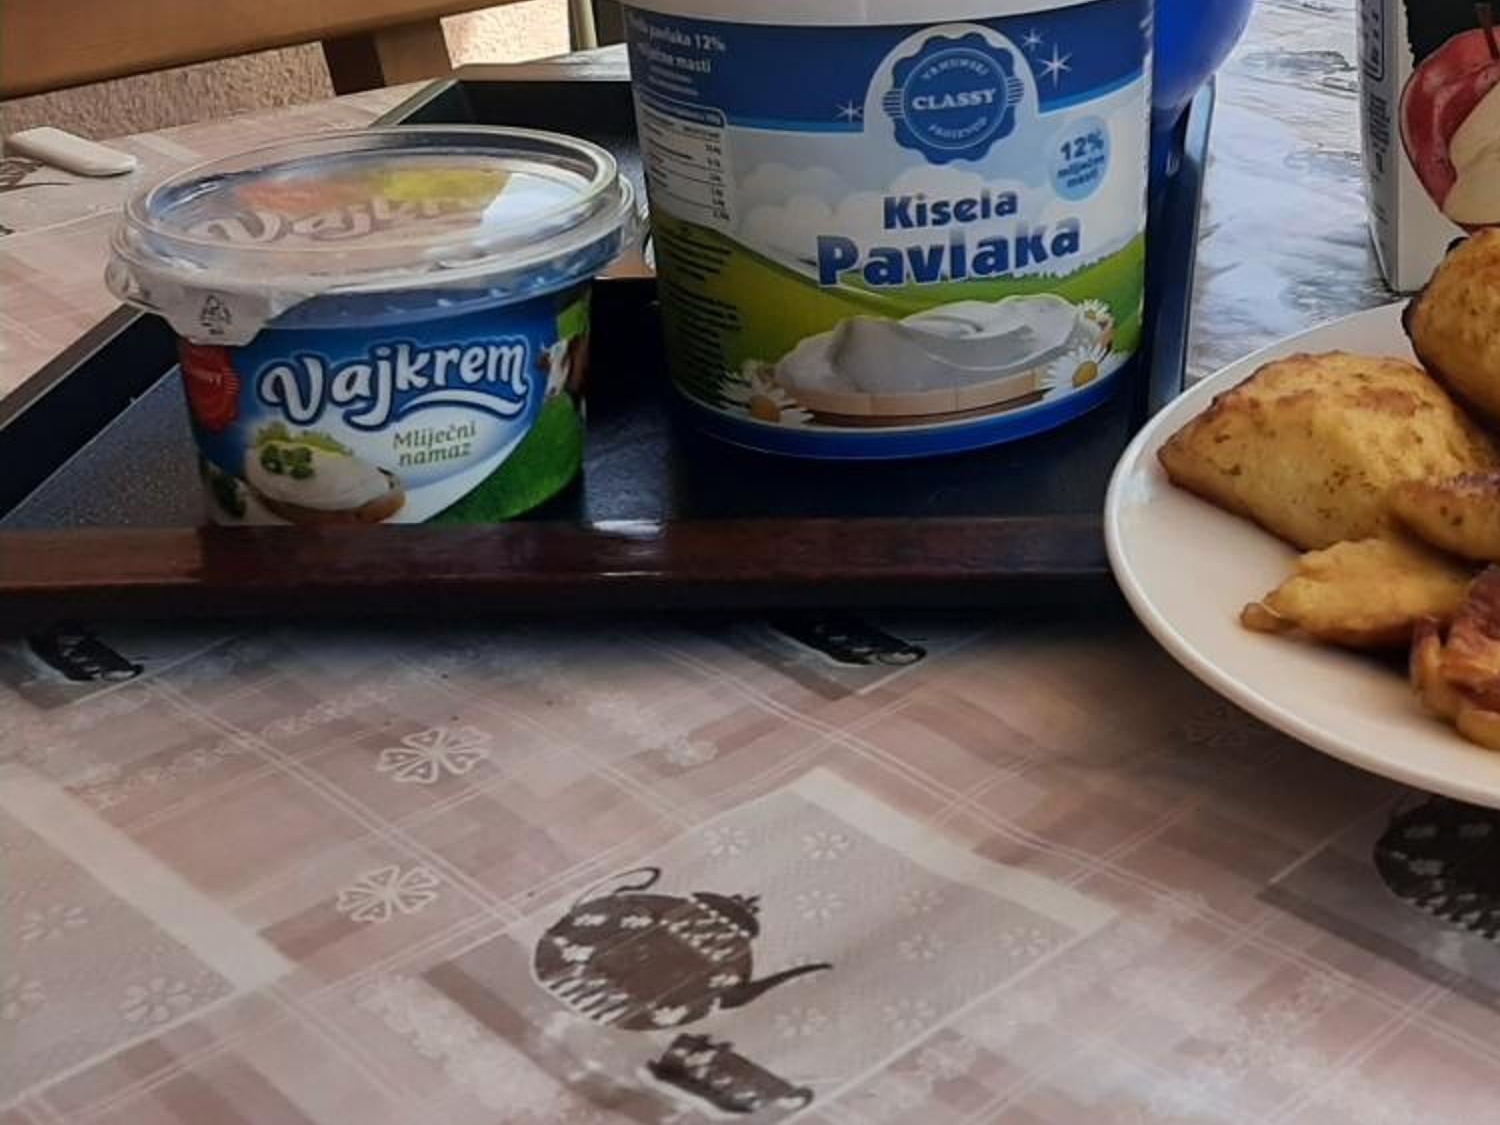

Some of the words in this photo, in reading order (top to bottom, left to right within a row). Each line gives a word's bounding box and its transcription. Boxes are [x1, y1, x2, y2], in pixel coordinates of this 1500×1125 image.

[911, 88, 996, 111] CLASSY
[1060, 129, 1104, 161] 12%
[883, 188, 1018, 229] Kisela
[817, 217, 1081, 286] Pavlaka
[259, 339, 529, 428] Vajkrem
[398, 443, 472, 467] namaz
